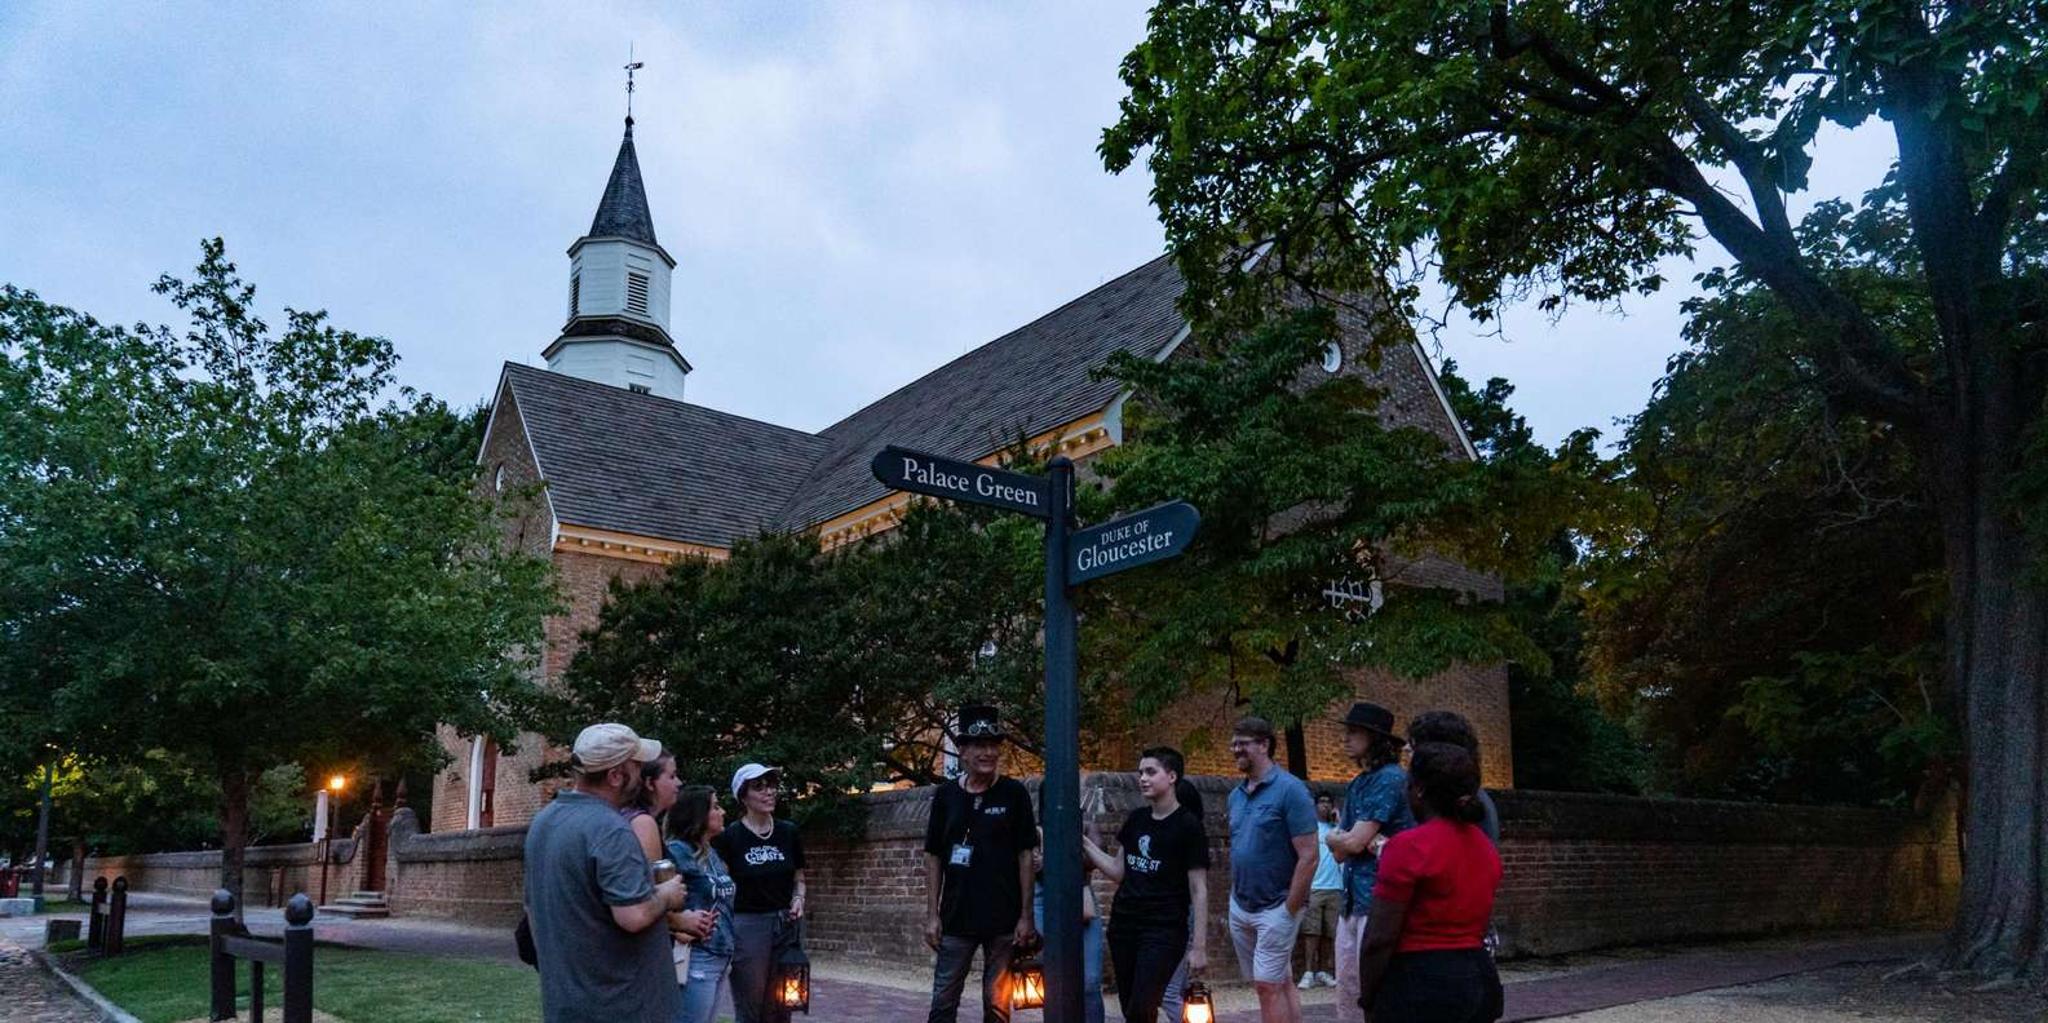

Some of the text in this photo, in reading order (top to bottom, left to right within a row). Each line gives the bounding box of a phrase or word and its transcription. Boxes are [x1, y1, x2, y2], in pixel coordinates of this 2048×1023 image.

[902, 457, 1038, 506] Palace Green
[1078, 531, 1173, 571] Gloucester
[1101, 520, 1150, 546] DUKE OF
